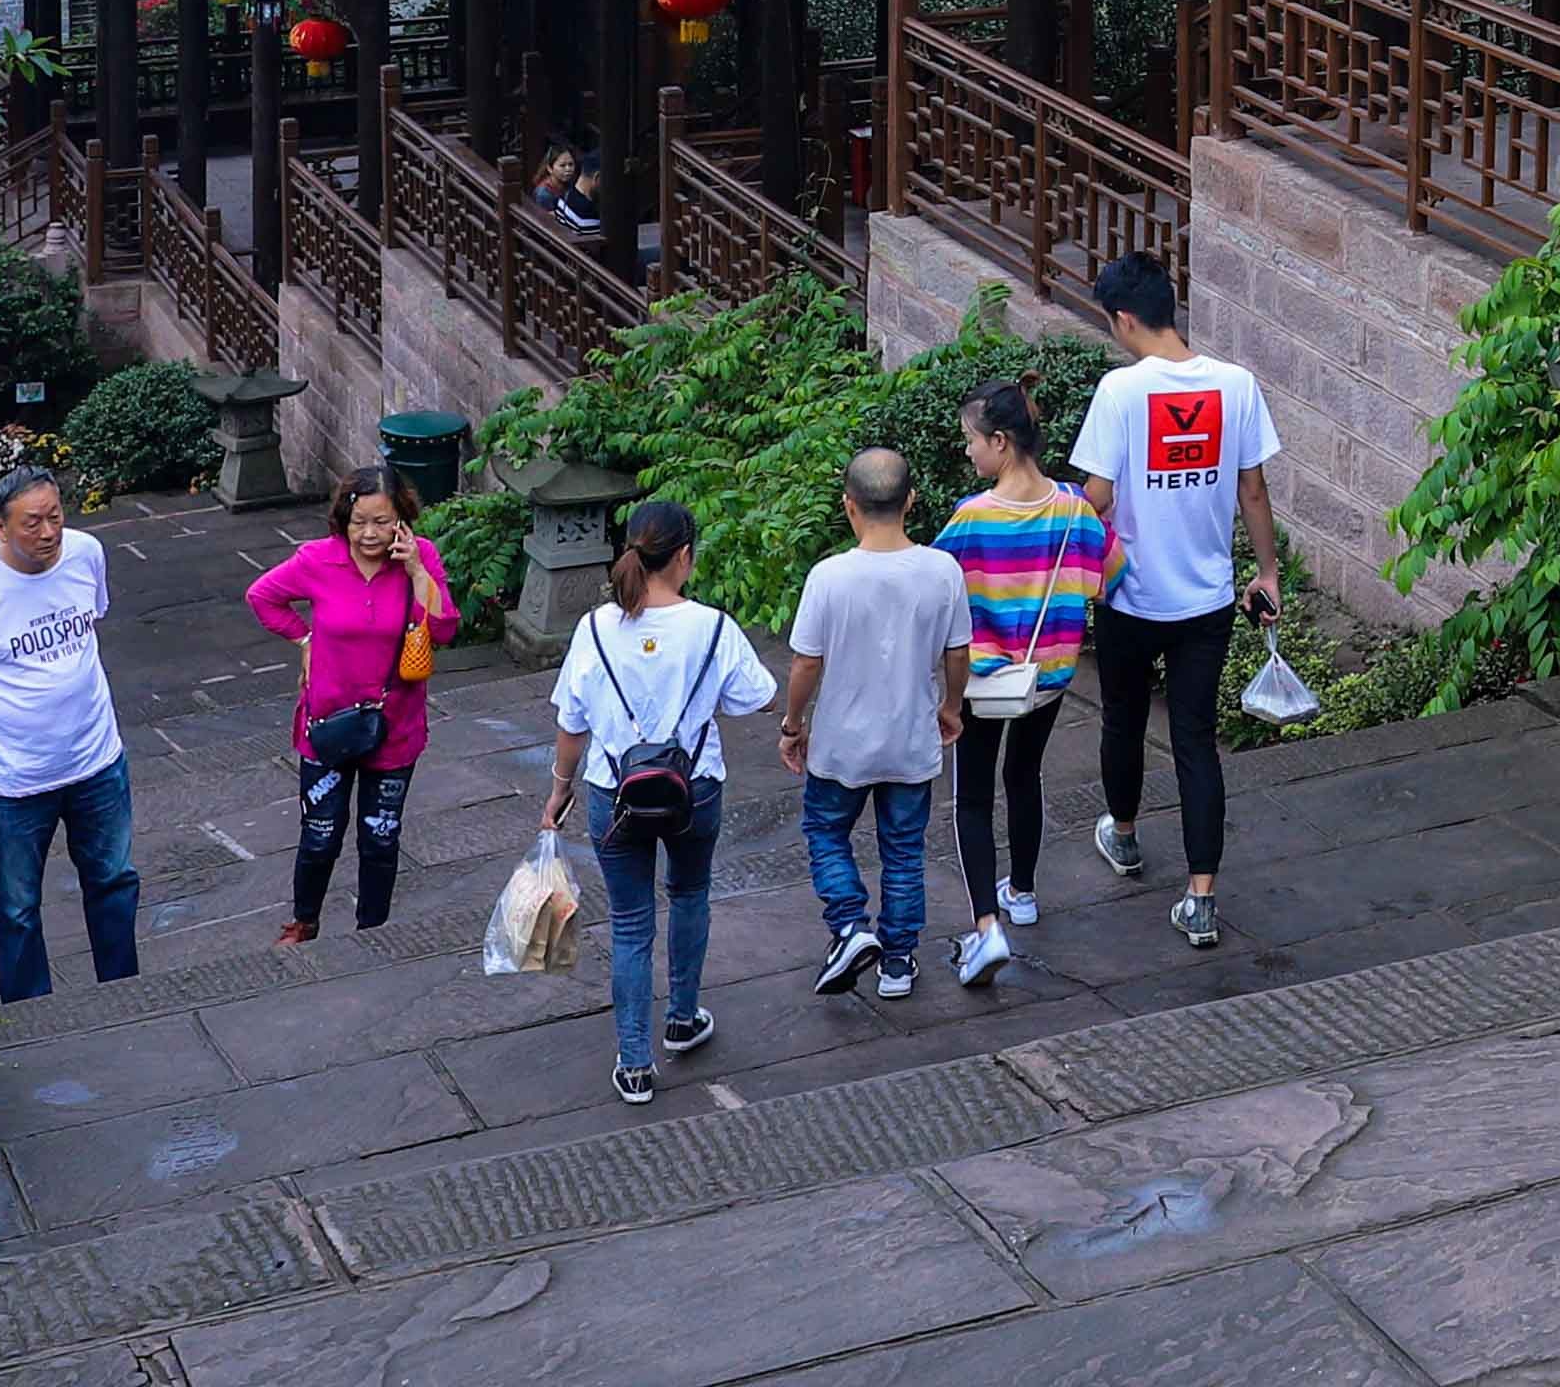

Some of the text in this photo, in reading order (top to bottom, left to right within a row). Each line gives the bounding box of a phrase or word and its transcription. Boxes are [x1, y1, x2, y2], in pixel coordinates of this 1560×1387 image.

[1167, 444, 1204, 464] 20
[1147, 469, 1219, 490] HERO
[10, 626, 55, 660] POLO
[40, 648, 60, 664] NEW
[307, 769, 342, 806] PARIS
